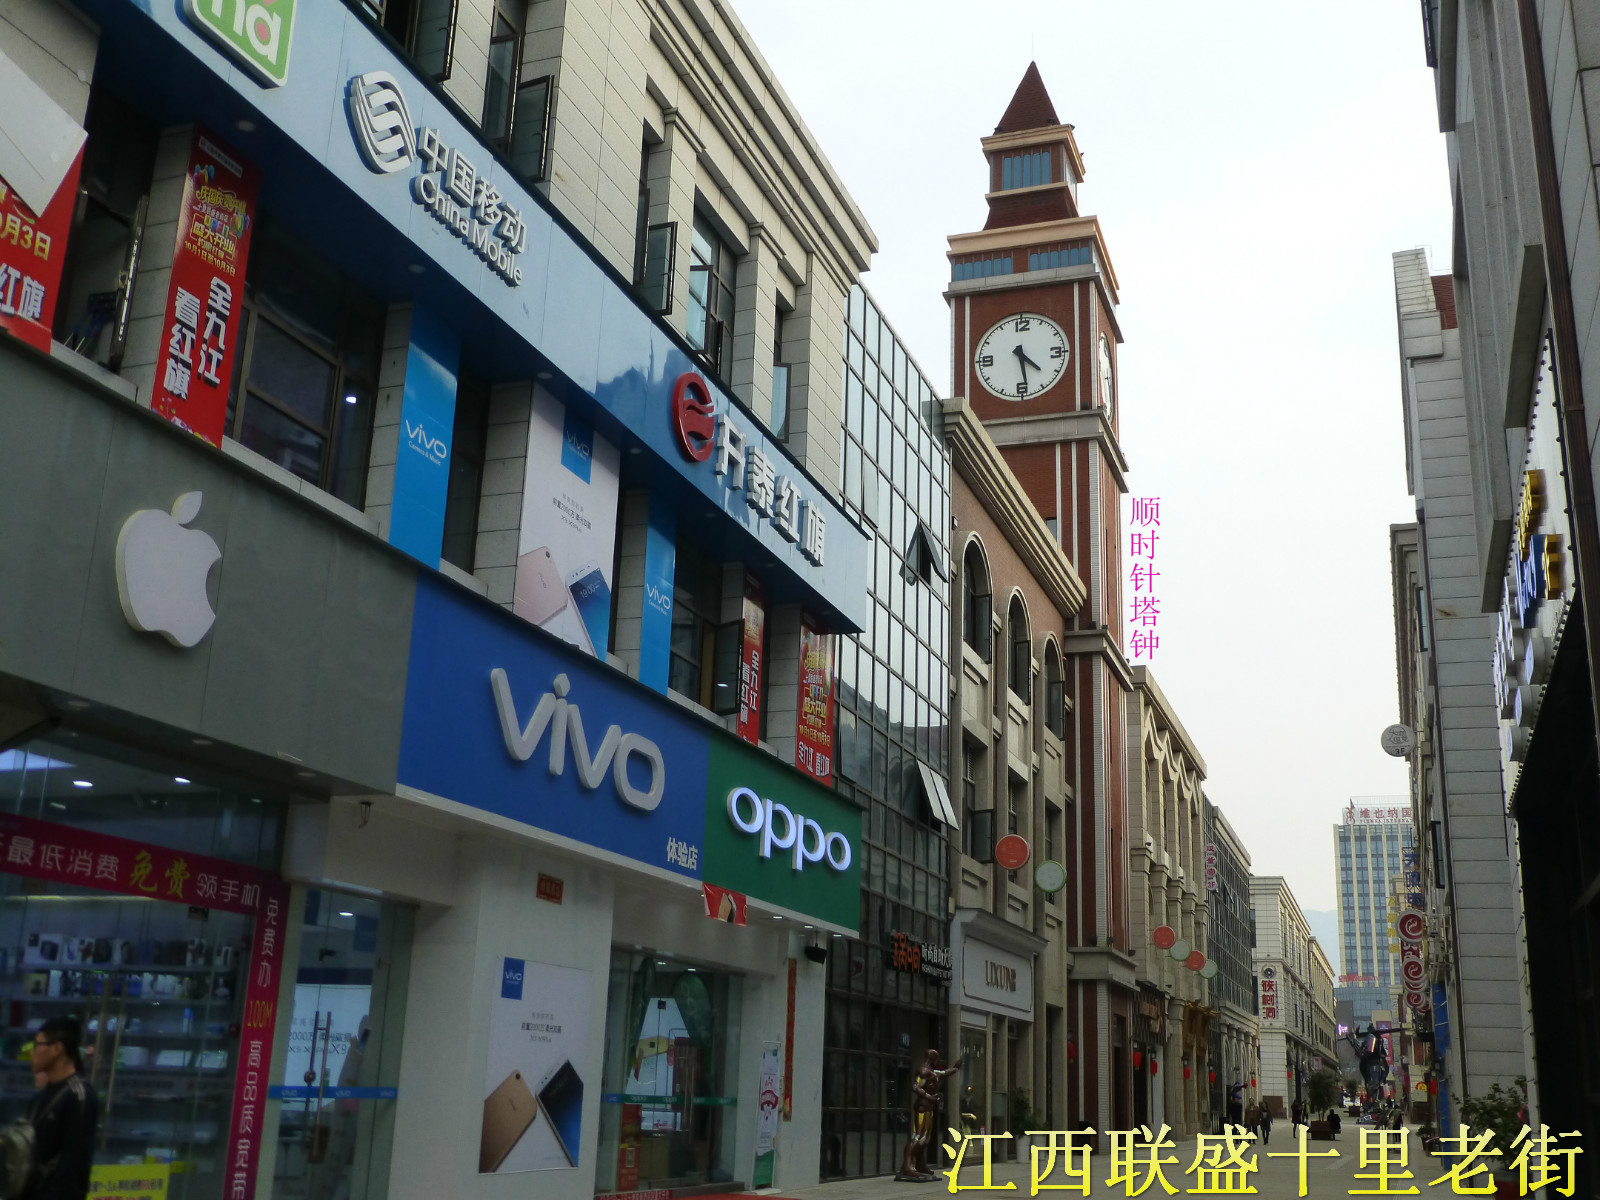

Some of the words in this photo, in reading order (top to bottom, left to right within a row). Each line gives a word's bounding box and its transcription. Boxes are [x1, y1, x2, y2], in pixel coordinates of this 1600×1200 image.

[418, 126, 527, 254] 中国移动
[0, 212, 52, 261] 月3日
[193, 221, 236, 256] 盛大开业
[415, 173, 470, 237] China
[467, 218, 523, 287] Mobile
[184, 241, 237, 278] 10月1日至10月3日
[163, 286, 201, 400] 看红旗
[197, 276, 233, 386] 全九江
[1014, 319, 1030, 332] 12
[982, 355, 994, 367] 9
[1050, 346, 1062, 359] 3
[1016, 382, 1028, 395] 6
[405, 419, 447, 459] vivo
[567, 430, 591, 457] vivo
[716, 413, 826, 568] 开泰红旗
[646, 583, 671, 610] vivo
[740, 661, 751, 725] 看红旗
[750, 649, 760, 711] 全九江
[490, 667, 666, 811] vivo
[1360, 807, 1414, 819] 维也纳国
[0, 833, 261, 910] 最低消费免费领手机
[667, 837, 698, 871] 体验店
[505, 970, 522, 982] vivo
